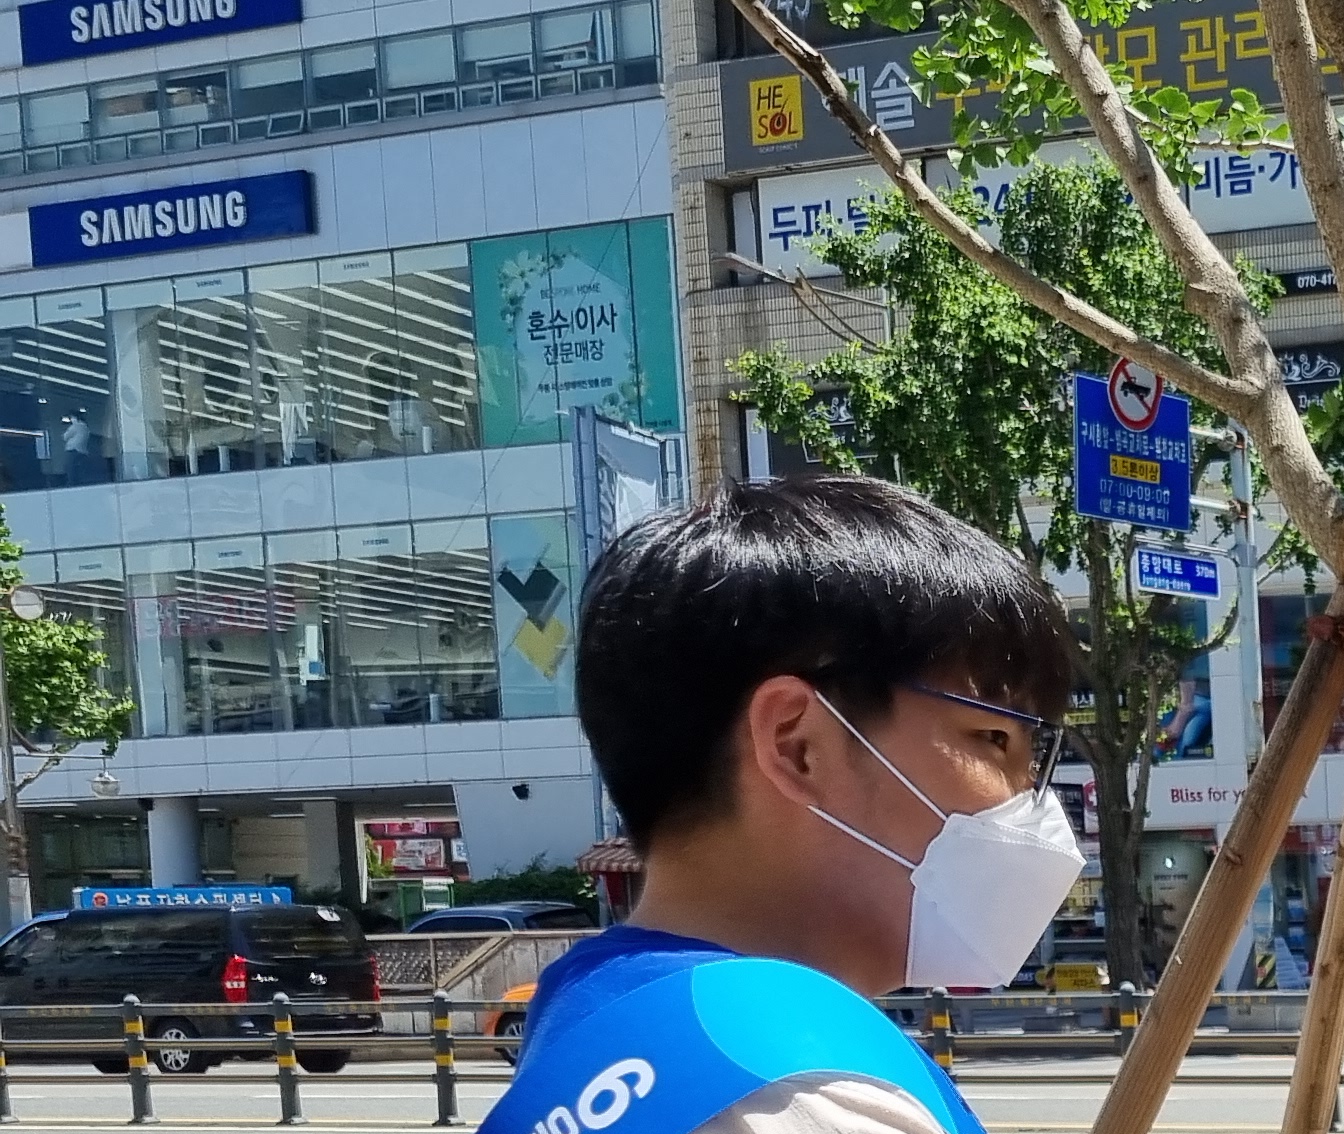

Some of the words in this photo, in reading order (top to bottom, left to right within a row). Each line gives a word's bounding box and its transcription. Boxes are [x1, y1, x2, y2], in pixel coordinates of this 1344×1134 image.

[71, 0, 237, 44] SAMSUNG
[757, 85, 783, 111] HE
[839, 61, 915, 131] 솔
[758, 110, 798, 139] SOL
[80, 190, 247, 248] SAMSUNG
[527, 309, 570, 341] 혼수
[576, 303, 618, 335] 이사
[543, 339, 605, 366] 전문매장
[1141, 552, 1184, 575] 중앙대로
[1170, 788, 1204, 804] Bliss
[1207, 787, 1229, 802] for
